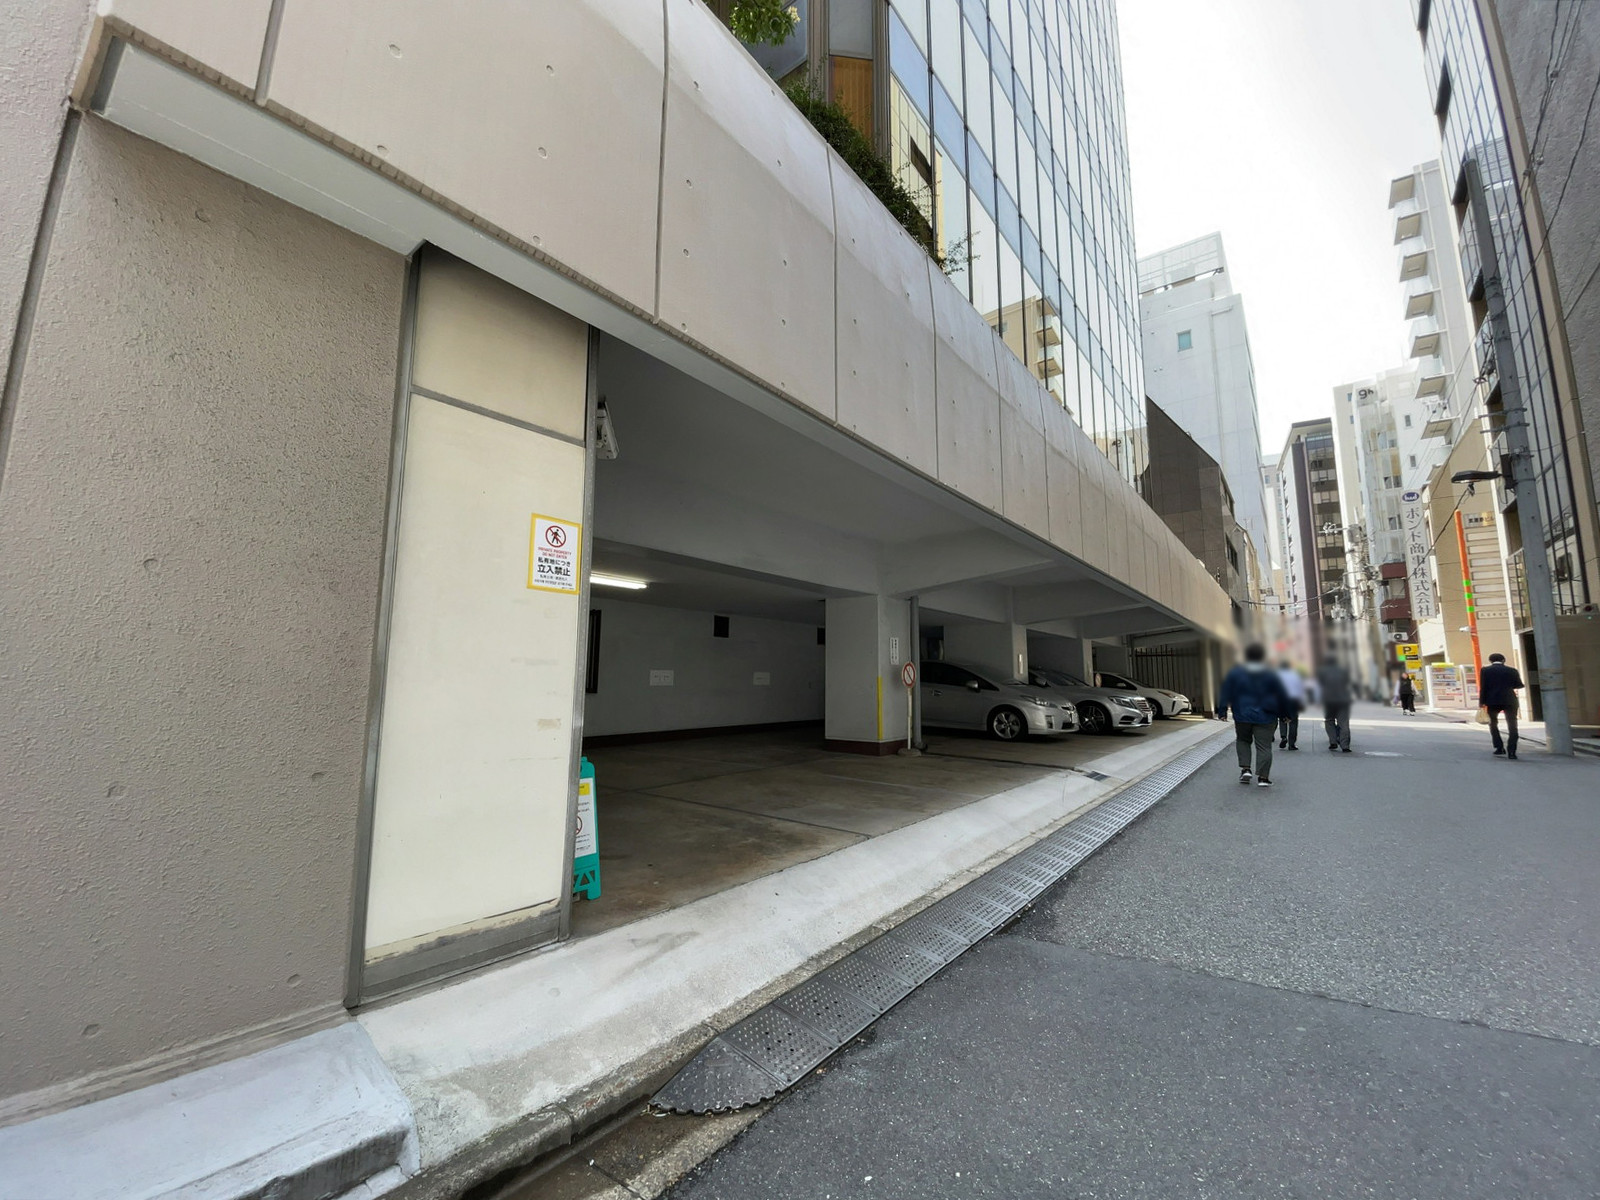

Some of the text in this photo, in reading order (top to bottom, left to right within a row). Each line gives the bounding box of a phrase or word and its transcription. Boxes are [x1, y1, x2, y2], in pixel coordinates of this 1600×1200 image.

[538, 556, 570, 567] 私有地につき
[1406, 507, 1431, 617] ボンド商事株式会社
[537, 564, 570, 576] 立入禁止
[1403, 646, 1411, 655] P
